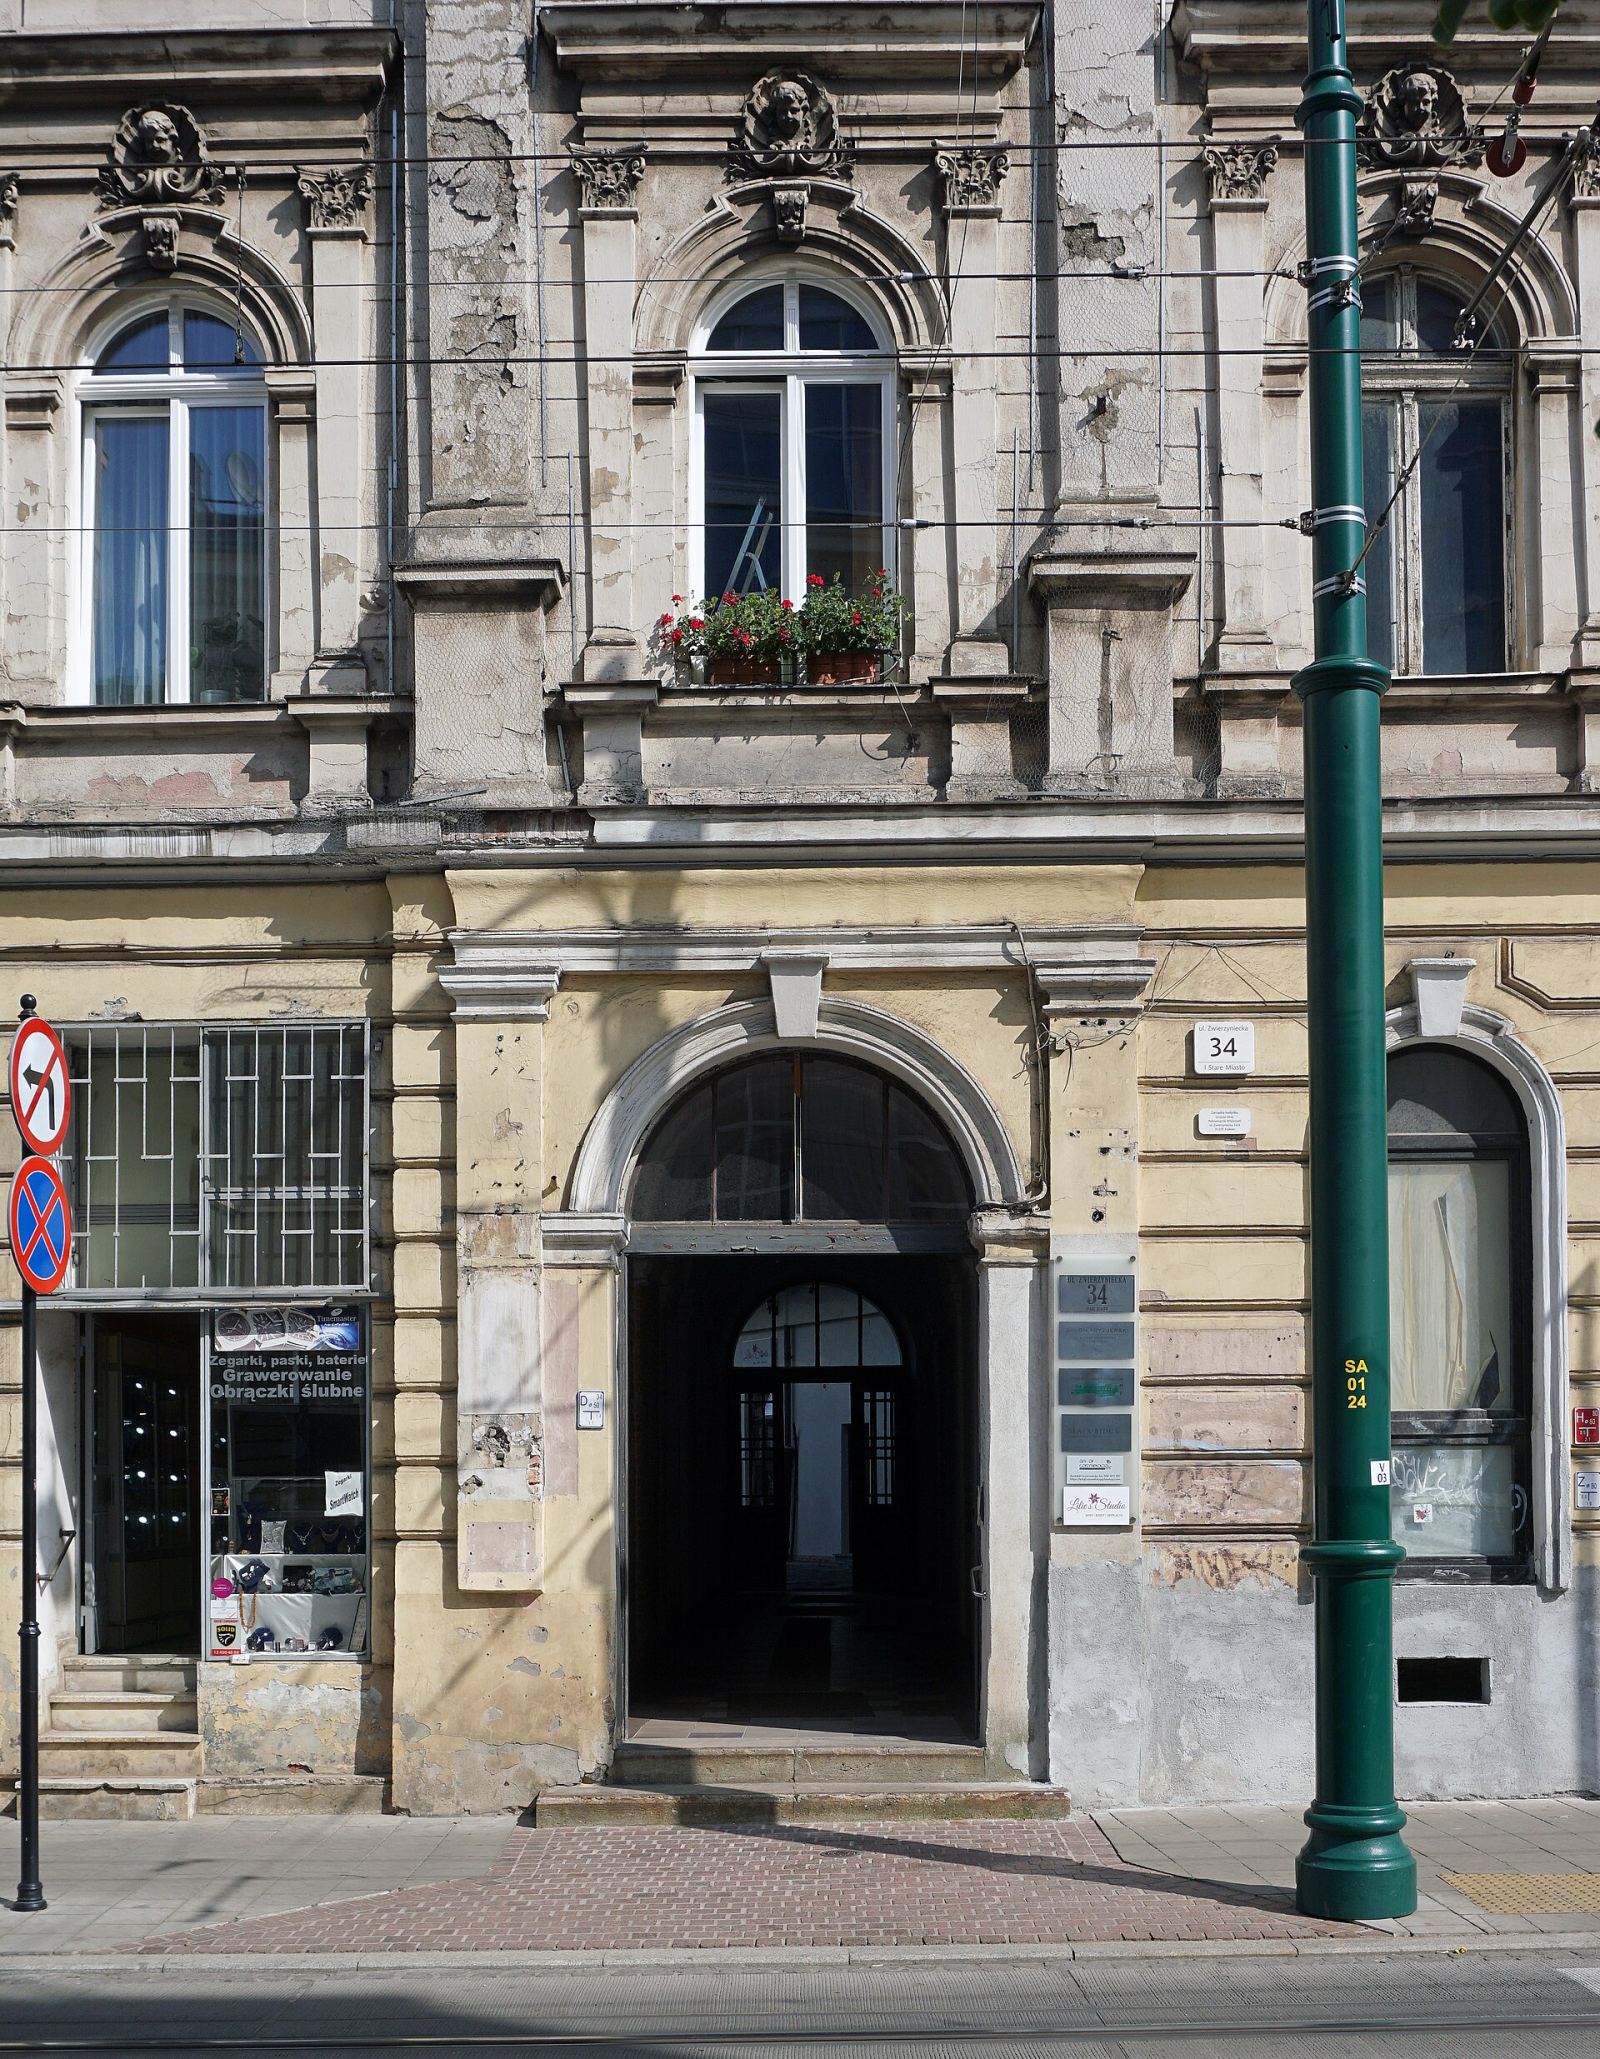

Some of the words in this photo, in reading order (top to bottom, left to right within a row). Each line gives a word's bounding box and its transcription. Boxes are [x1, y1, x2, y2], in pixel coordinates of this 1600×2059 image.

[1207, 1025, 1249, 1033] Zwierzyniecka
[1209, 1037, 1238, 1057] 34
[1087, 1284, 1108, 1305] 34
[210, 1355, 267, 1367] Zegarki,
[271, 1355, 313, 1368] paski,
[1345, 1359, 1369, 1373] SA
[223, 1369, 352, 1382] Grawerowanie
[1347, 1377, 1366, 1391] 01
[210, 1384, 294, 1402] Obrączki
[301, 1383, 365, 1398] ślubne
[580, 1395, 588, 1406] D
[1347, 1395, 1367, 1409] 24
[1576, 1411, 1584, 1423] H
[1378, 1462, 1386, 1473] V
[334, 1474, 352, 1487] Zegarki
[1377, 1473, 1388, 1483] 03
[1578, 1476, 1586, 1487] Z
[1094, 1497, 1127, 1511] Studio
